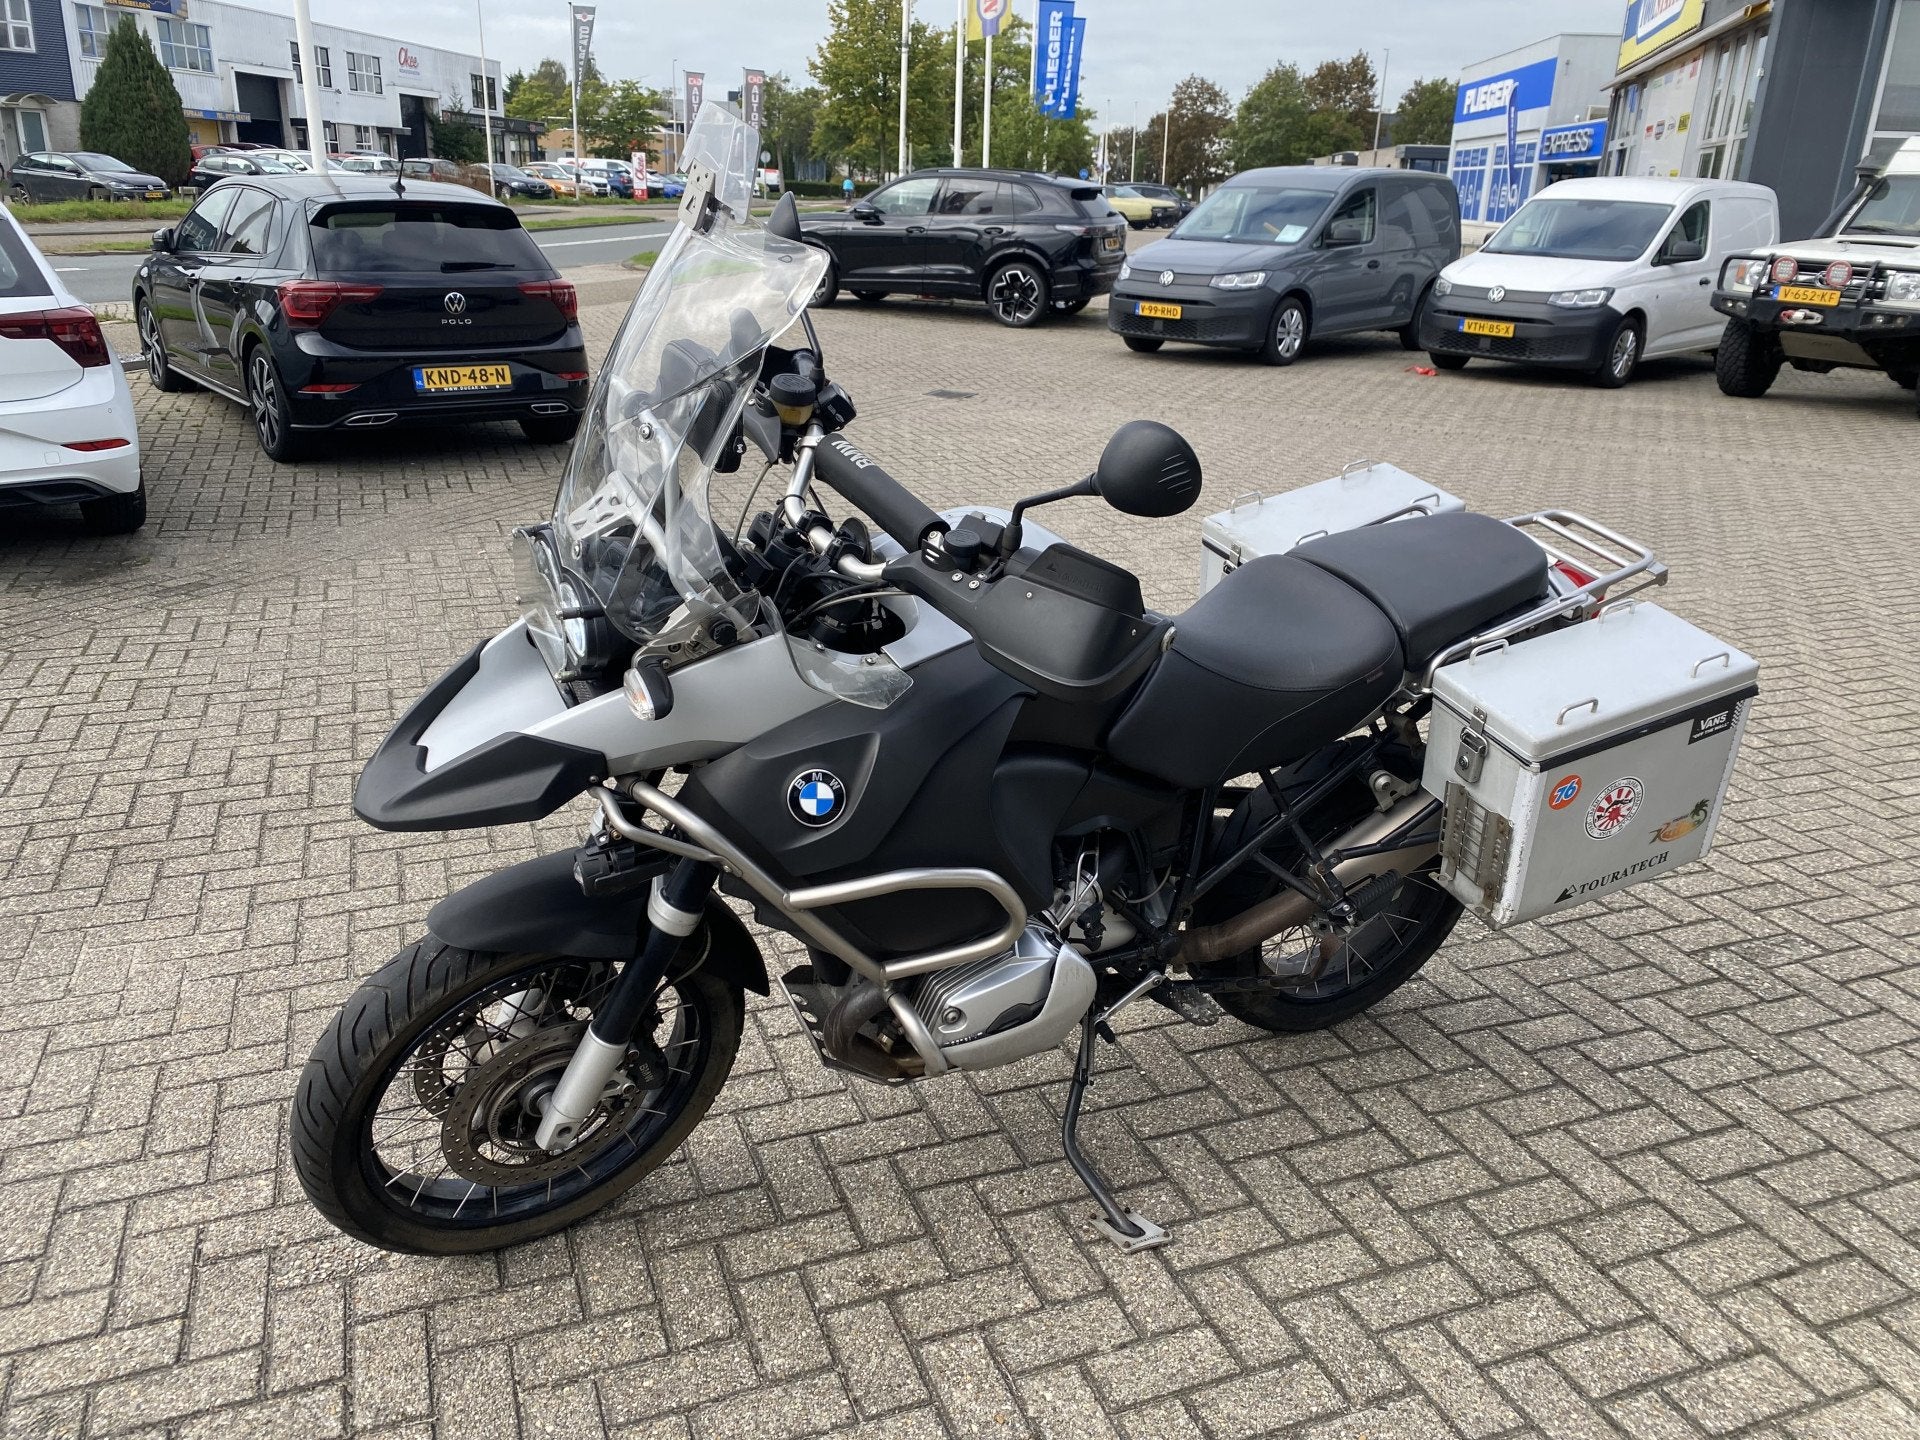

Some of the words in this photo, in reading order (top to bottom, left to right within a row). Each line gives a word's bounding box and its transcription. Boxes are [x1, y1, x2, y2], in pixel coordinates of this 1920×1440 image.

[1043, 10, 1063, 106] PLIEGER
[1463, 78, 1514, 115] PLIEGER
[1542, 128, 1594, 155] EXPRESS
[1783, 288, 1837, 303] V-652-KF
[1140, 304, 1179, 317] V-99-RHD
[425, 367, 507, 386] KND-48-N
[1700, 711, 1728, 731] VANS
[794, 772, 841, 790] BMW
[1552, 778, 1580, 806] 76
[1579, 850, 1669, 895] TOURATECH
